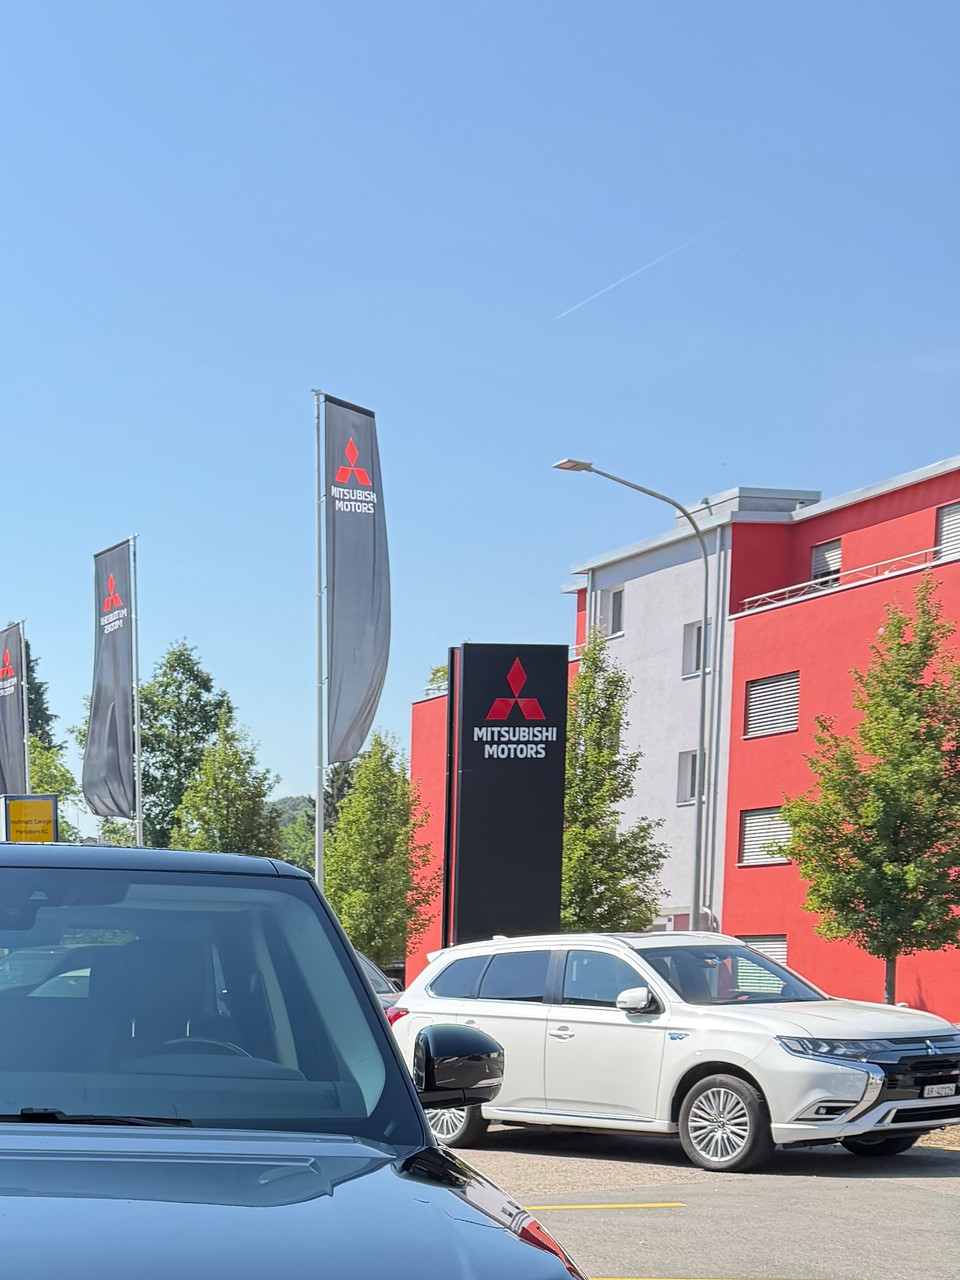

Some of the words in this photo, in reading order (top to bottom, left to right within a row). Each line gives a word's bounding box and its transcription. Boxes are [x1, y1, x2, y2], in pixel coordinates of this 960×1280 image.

[331, 485, 377, 503] MITSUBISH
[335, 499, 374, 513] MOTORS
[473, 727, 557, 741] MITSUBISHI
[484, 744, 546, 758] MOTORS
